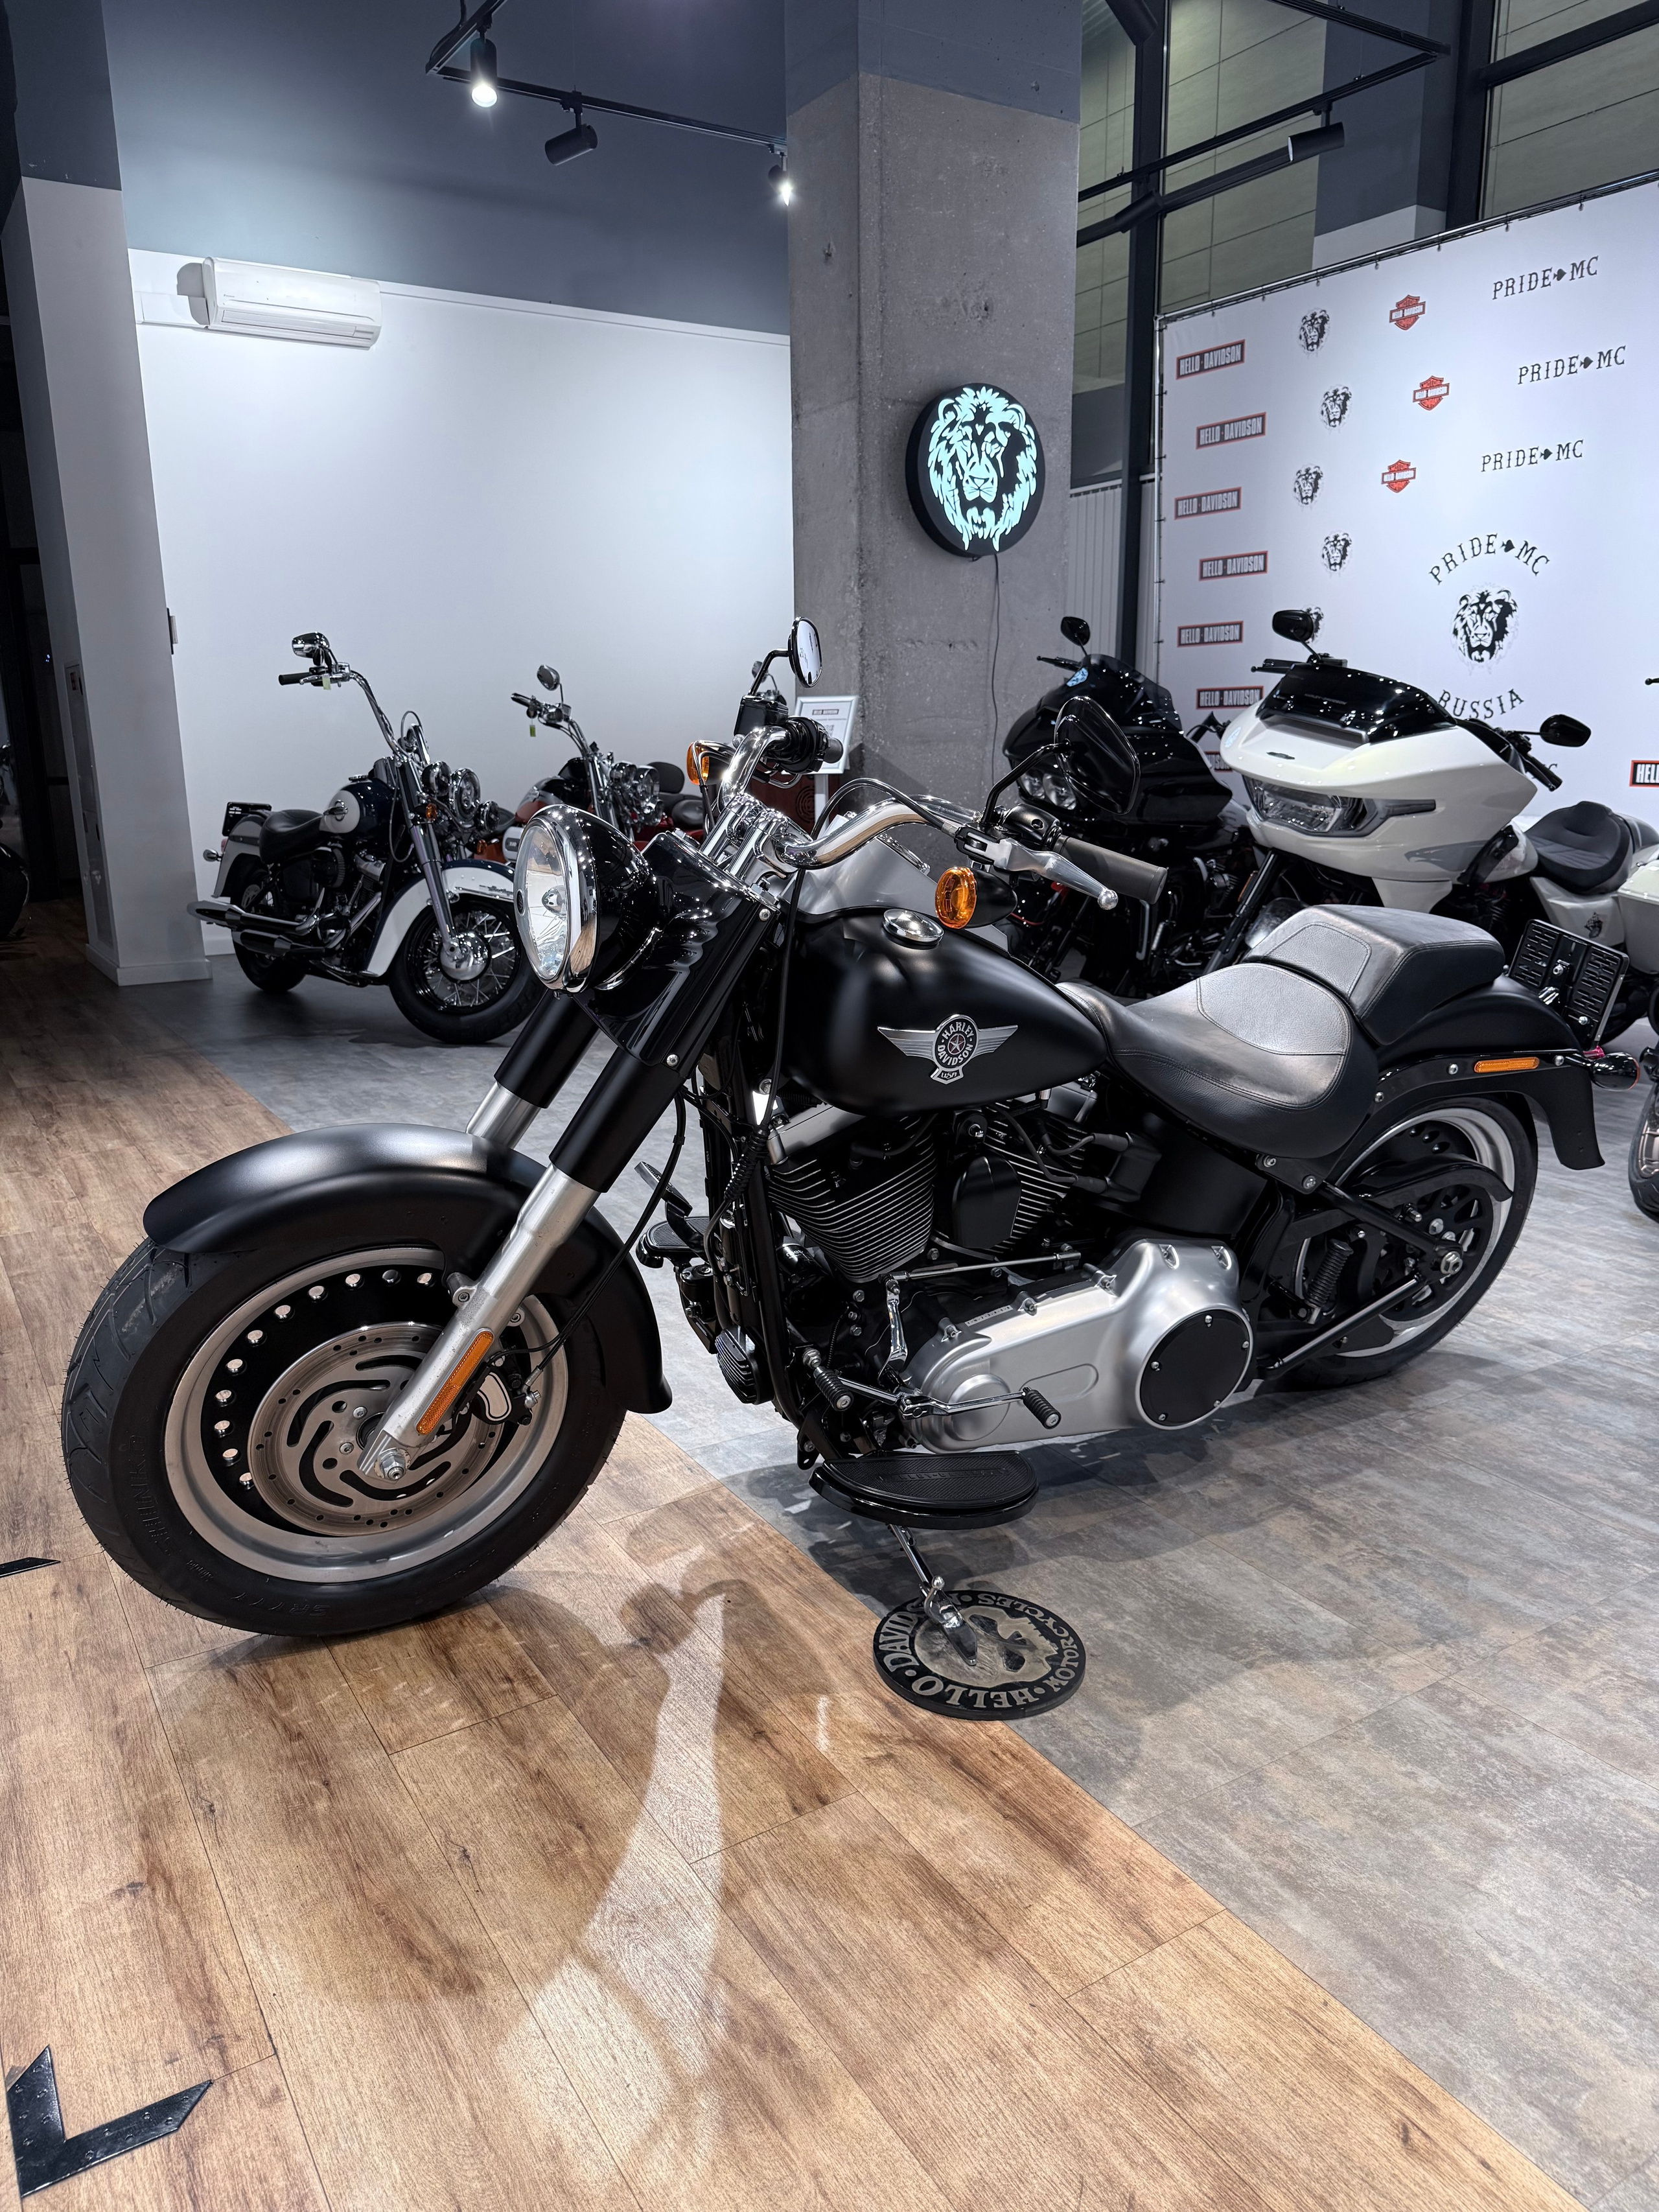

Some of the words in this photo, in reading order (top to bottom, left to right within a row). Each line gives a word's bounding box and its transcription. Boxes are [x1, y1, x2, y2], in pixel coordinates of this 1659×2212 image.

[1492, 266, 1553, 300] PRIDE
[1568, 255, 1599, 281] MC
[1179, 355, 1200, 376] HELLO
[1204, 344, 1241, 369] DAVIDSON
[1517, 354, 1580, 385] PRIDE
[1595, 345, 1627, 369] MC
[1200, 426, 1220, 445] HELLO
[1224, 417, 1262, 440] DAVIDSON
[1480, 446, 1540, 472] PRIDE
[1555, 439, 1584, 461] MC
[1178, 498, 1198, 516] HELLO
[1201, 491, 1238, 512] DAVIDSON
[1203, 560, 1223, 577] HELLO
[1227, 555, 1264, 574] DAVIDSON
[1428, 533, 1498, 585] PRIDE
[1514, 540, 1551, 576] MC
[1180, 628, 1200, 644] HELLO
[1203, 623, 1240, 642] DAVIDSON
[1200, 691, 1220, 706] HELLO
[1224, 689, 1260, 706] DAVIDSON
[1437, 688, 1524, 720] RUSSIA
[1636, 763, 1659, 784] HELL
[941, 1021, 975, 1040] HARLEY
[937, 1043, 973, 1066] DAVIDSON
[977, 1593, 1080, 1692] MOTORCYCLES
[911, 1675, 1039, 1708] HELLO
